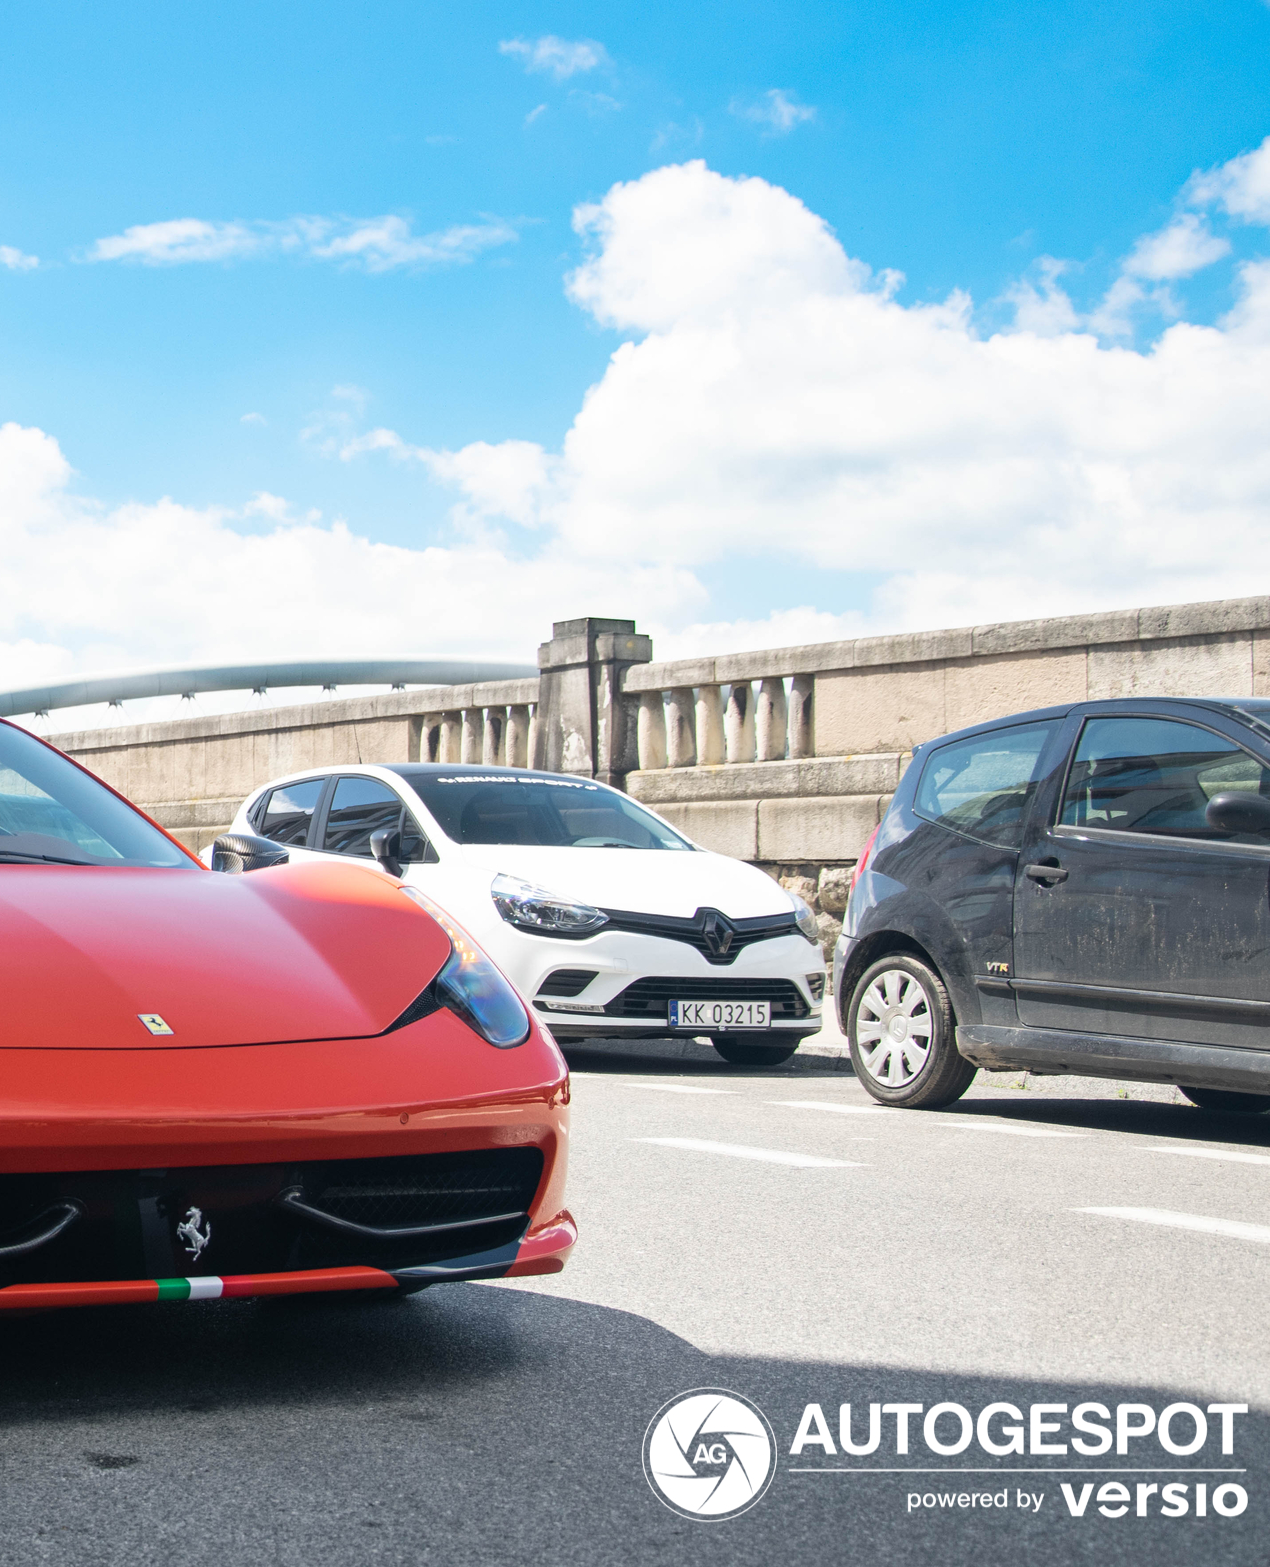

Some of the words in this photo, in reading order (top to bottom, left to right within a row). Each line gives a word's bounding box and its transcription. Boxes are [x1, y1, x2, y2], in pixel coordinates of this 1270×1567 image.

[518, 777, 584, 789] SPORT
[986, 961, 1009, 972] VTR
[682, 1003, 705, 1023] KK
[713, 1004, 765, 1024] 03215
